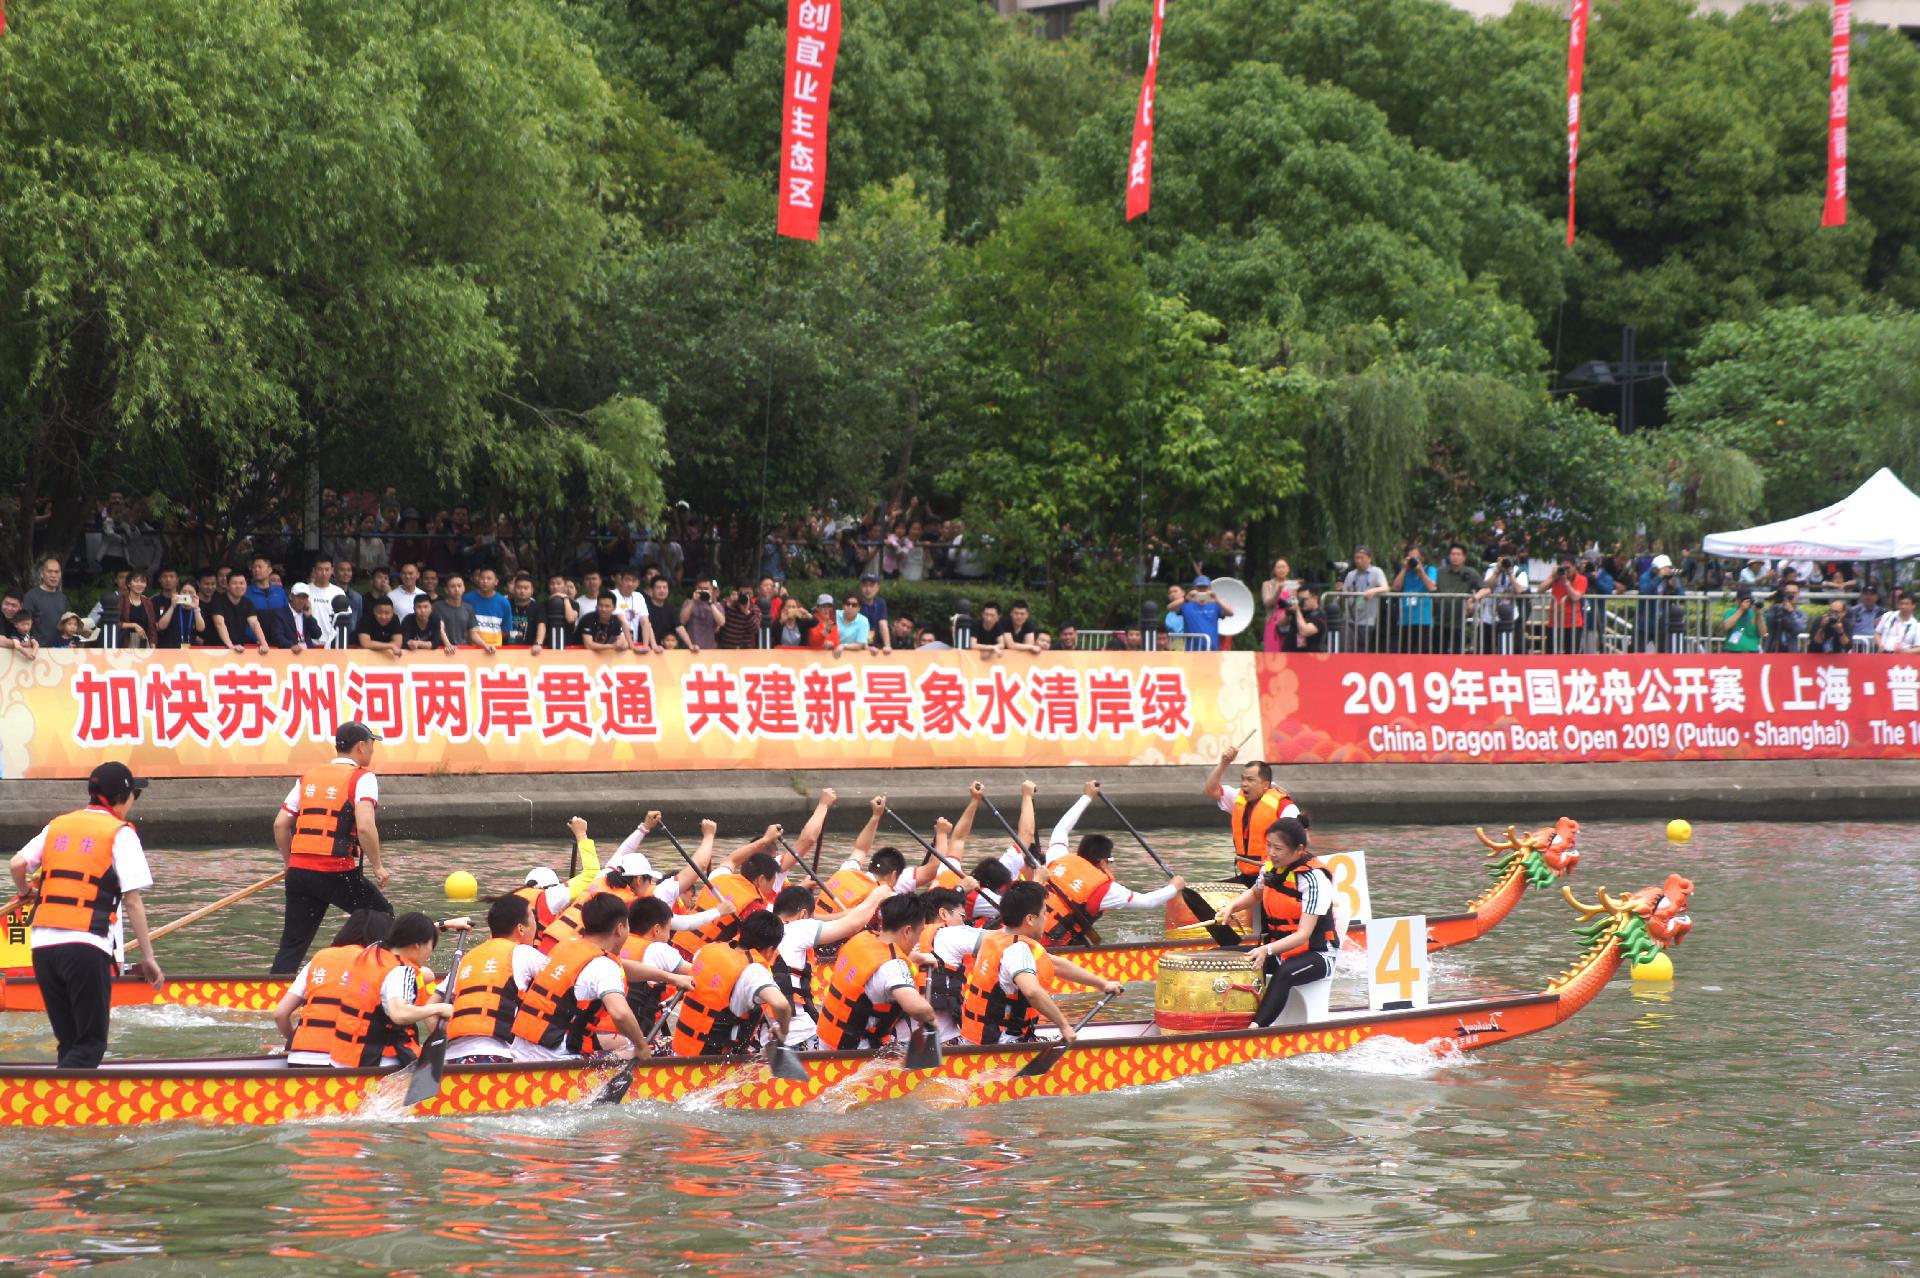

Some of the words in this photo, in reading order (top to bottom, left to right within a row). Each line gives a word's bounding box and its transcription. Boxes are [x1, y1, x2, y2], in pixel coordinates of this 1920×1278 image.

[76, 667, 658, 741] 加快苏州河两岸贯通
[685, 667, 1190, 737] 共建新景象水清岸绿
[1368, 724, 1427, 752] China
[1431, 724, 1507, 757] Dragon
[1510, 724, 1559, 751] Boat
[1563, 724, 1618, 755] Open
[1622, 722, 1670, 749] 2019
[1868, 720, 1906, 745] The
[1326, 854, 1361, 918] 3
[1375, 919, 1420, 1000] 4
